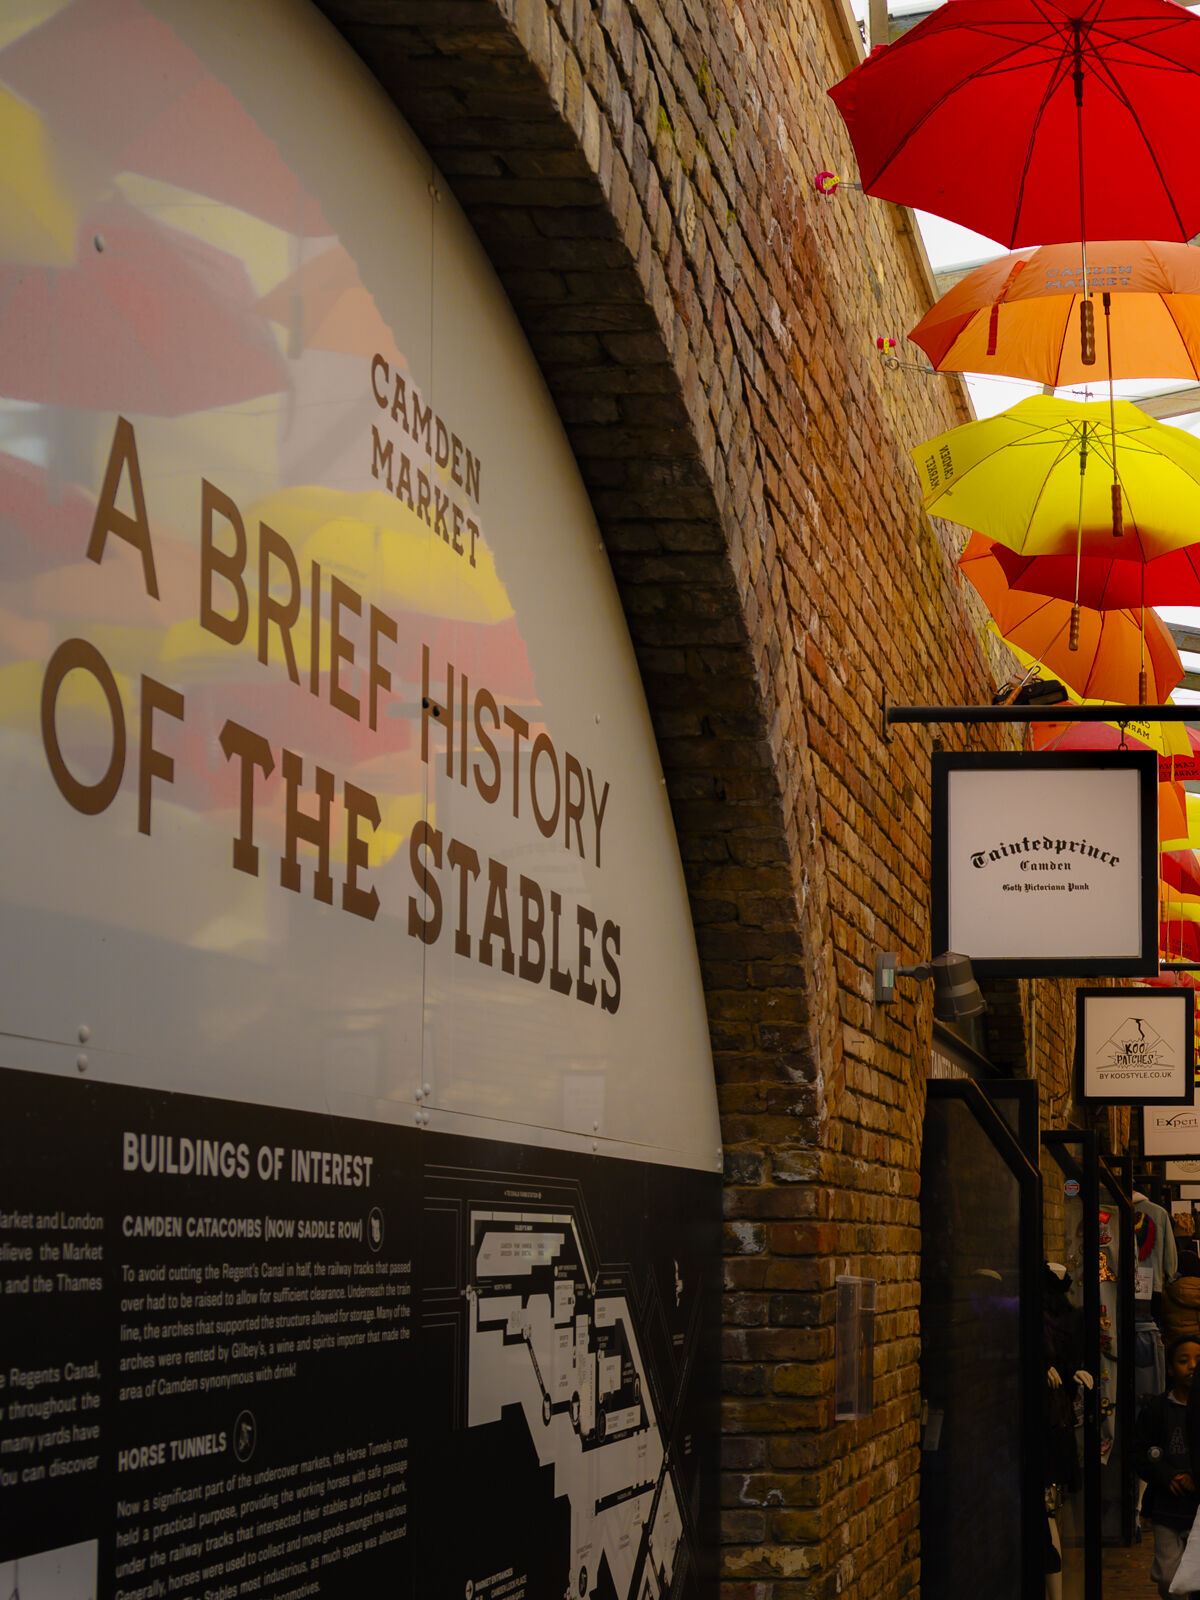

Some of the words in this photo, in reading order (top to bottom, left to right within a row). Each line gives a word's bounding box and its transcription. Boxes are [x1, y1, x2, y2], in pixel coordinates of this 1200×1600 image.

[1046, 265, 1132, 279] CAMDEN
[1046, 277, 1131, 290] MARKET
[371, 354, 480, 504] CAMDEN
[371, 424, 479, 568] MARKET
[86, 415, 160, 601] A
[201, 477, 397, 732] BRIEF
[421, 643, 610, 868] HISTORY
[41, 638, 185, 836] OF
[219, 718, 381, 922] THE
[408, 820, 621, 1014] STABLES
[970, 836, 1120, 869] Taintedprince
[1019, 860, 1072, 871] Camden
[1002, 882, 1022, 892] Goth
[1067, 882, 1089, 892] Punk
[1116, 1054, 1154, 1065] PATCHES
[1125, 1043, 1145, 1055] KOO
[1110, 1071, 1172, 1080] KOOSTYLE.CO.UK
[1156, 1117, 1197, 1128] Expert
[122, 1131, 250, 1180] BUILDINGS
[257, 1145, 285, 1181] OF
[291, 1149, 374, 1188] INTEREST
[0, 1210, 34, 1230] arket
[36, 1211, 60, 1230] and
[60, 1211, 104, 1231] London
[122, 1215, 183, 1238] CAMDEN
[186, 1217, 262, 1240] CATACOMBS
[264, 1216, 295, 1242] (NOW
[297, 1220, 336, 1240] SADDLE
[338, 1219, 363, 1243] ROW)
[40, 1242, 61, 1261] the
[63, 1242, 104, 1261] Market
[5, 1274, 31, 1294] and
[33, 1274, 54, 1293] the
[56, 1273, 103, 1292] Thames
[121, 1264, 135, 1282] To
[138, 1264, 167, 1282] avoid
[169, 1264, 203, 1284] cutting
[204, 1264, 220, 1280] the
[261, 1261, 286, 1278] Canal
[287, 1262, 294, 1277] in
[313, 1261, 327, 1276] the
[327, 1261, 352, 1278] railway
[353, 1261, 375, 1275] tracks
[375, 1260, 389, 1274] that
[389, 1260, 412, 1277] passed
[121, 1298, 145, 1312] over
[147, 1293, 167, 1310] had
[168, 1295, 180, 1309] to
[180, 1292, 194, 1309] be
[194, 1290, 223, 1307] raised
[224, 1291, 235, 1306] to
[236, 1289, 259, 1306] allow
[259, 1288, 272, 1304] for
[143, 1321, 161, 1340] the
[161, 1320, 195, 1339] arches
[195, 1319, 215, 1337] that
[215, 1314, 261, 1336] supported
[260, 1314, 275, 1330] the
[120, 1352, 155, 1371] arches
[157, 1352, 183, 1368] were
[184, 1345, 215, 1364] rented
[217, 1343, 230, 1363] by
[268, 1343, 275, 1356] a
[276, 1338, 296, 1353] wine
[296, 1335, 312, 1351] and
[10, 1368, 61, 1390] Regents
[119, 1384, 143, 1402] area
[144, 1379, 157, 1399] of
[157, 1375, 199, 1397] Camden
[199, 1371, 255, 1392] synonymous
[255, 1364, 274, 1382] with
[9, 1396, 77, 1420] throughout
[81, 1392, 101, 1410] the
[1, 1435, 36, 1453] many
[37, 1426, 71, 1452] yards
[72, 1424, 100, 1442] have
[118, 1442, 166, 1473] HORSE
[169, 1431, 228, 1462] TUNNELS
[22, 1466, 46, 1483] can
[49, 1456, 100, 1478] discover
[116, 1499, 141, 1519] Now
[143, 1498, 151, 1513] a
[152, 1486, 203, 1512] significant
[204, 1479, 225, 1502] part
[226, 1474, 238, 1492] of
[238, 1473, 253, 1489] the
[253, 1465, 300, 1485] undercover
[116, 1526, 140, 1549] held
[142, 1527, 151, 1542] a
[152, 1511, 198, 1543] practical
[240, 1493, 280, 1518] providing
[115, 1556, 147, 1579] under
[149, 1550, 167, 1569] the
[168, 1541, 204, 1562] railway
[204, 1530, 234, 1552] tracks
[236, 1525, 255, 1543] that
